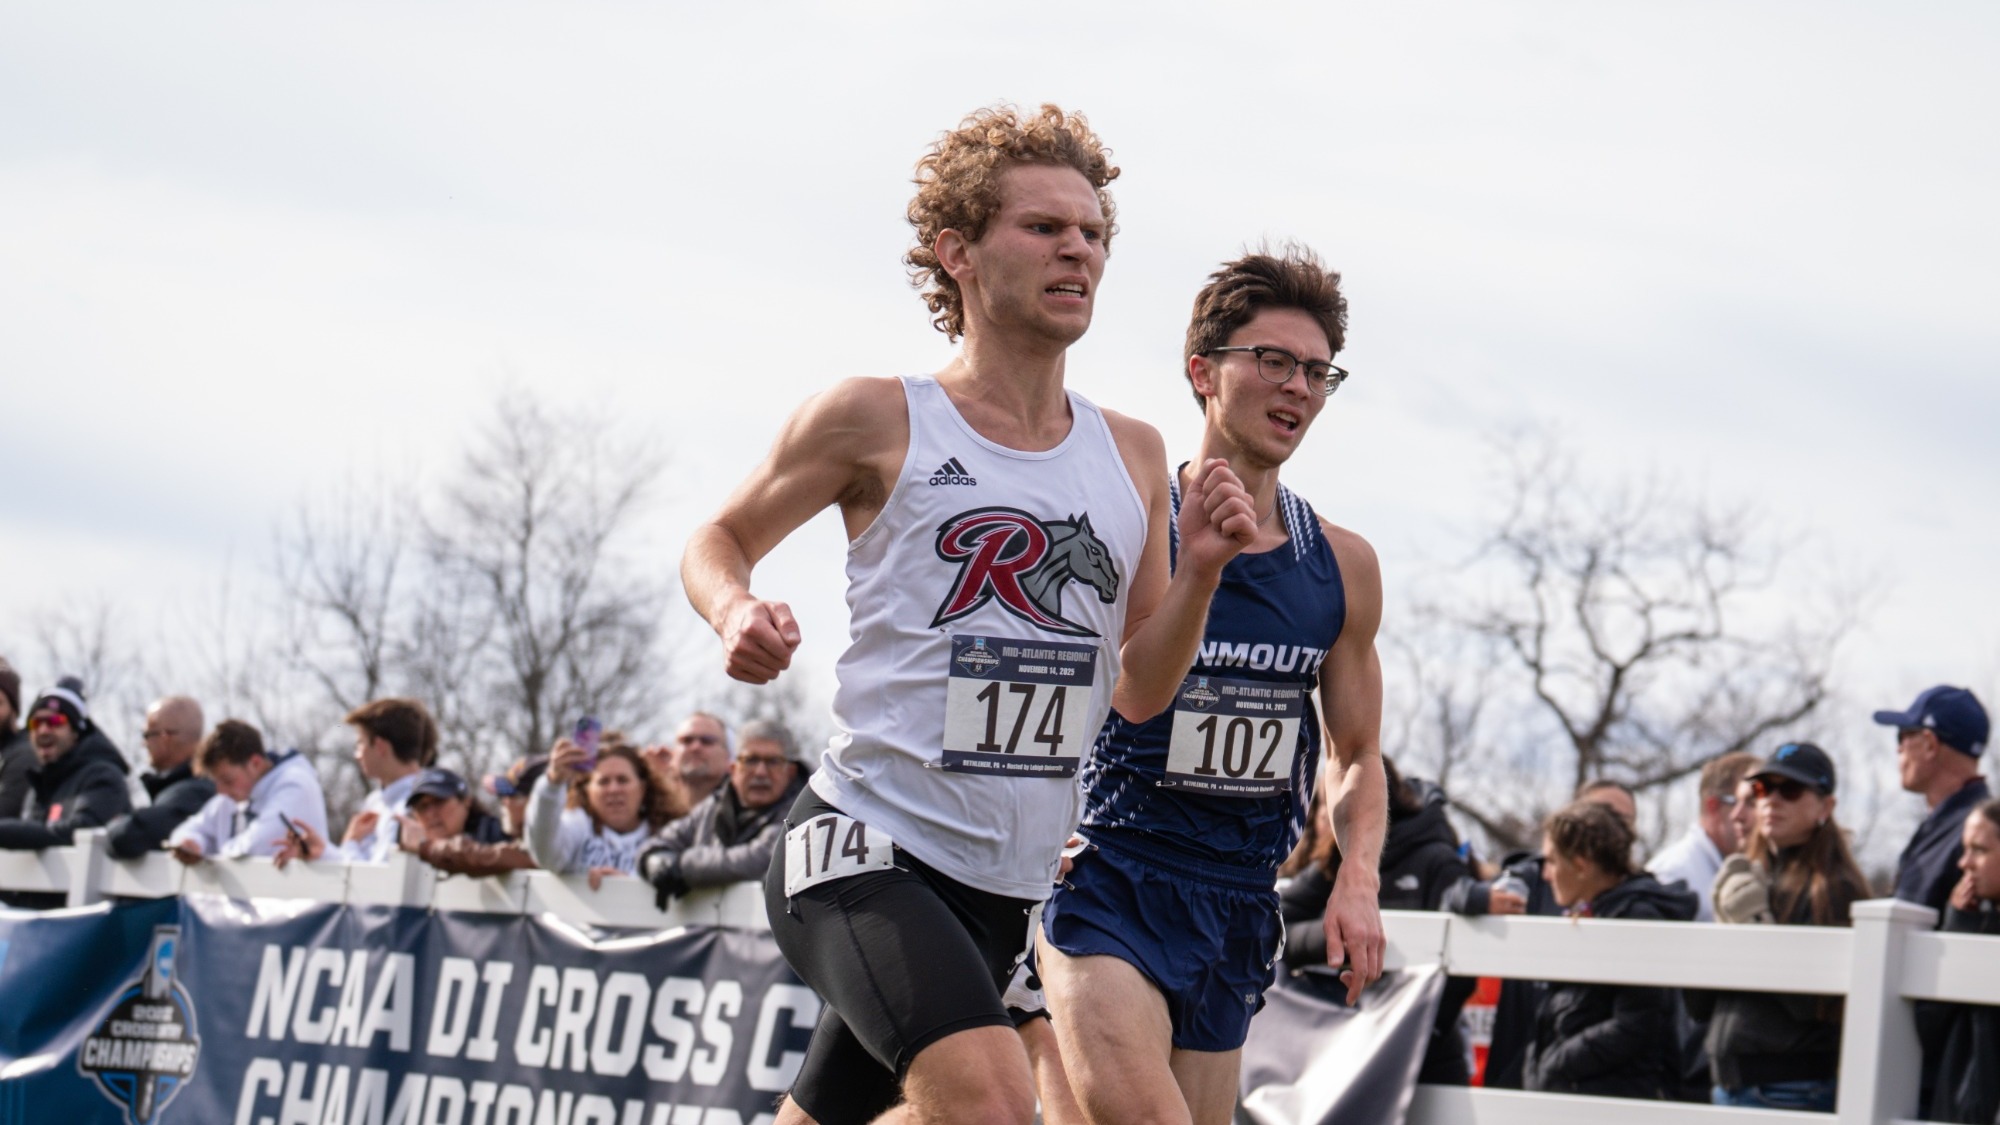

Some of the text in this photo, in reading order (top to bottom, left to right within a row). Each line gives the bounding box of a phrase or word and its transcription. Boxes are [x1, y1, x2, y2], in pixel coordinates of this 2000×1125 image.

[929, 474, 977, 486] adidas
[1002, 646, 1056, 660] MID-ATLANTIC
[1057, 651, 1091, 662] REGIONAL
[1018, 664, 1075, 676] NOVEMBER 14, 2025
[1221, 685, 1272, 698] MID-ATLANTIC
[1272, 689, 1300, 699] REGIONAL
[1235, 701, 1287, 711] NOVEMBER 14, 2025
[976, 681, 1067, 756] 174
[1194, 715, 1283, 778] 102
[962, 759, 993, 769] BETHLEHEM,
[801, 816, 869, 878] 174
[245, 944, 416, 1053] NCAA
[426, 956, 513, 1062] DI
[514, 964, 743, 1087] CROSS
